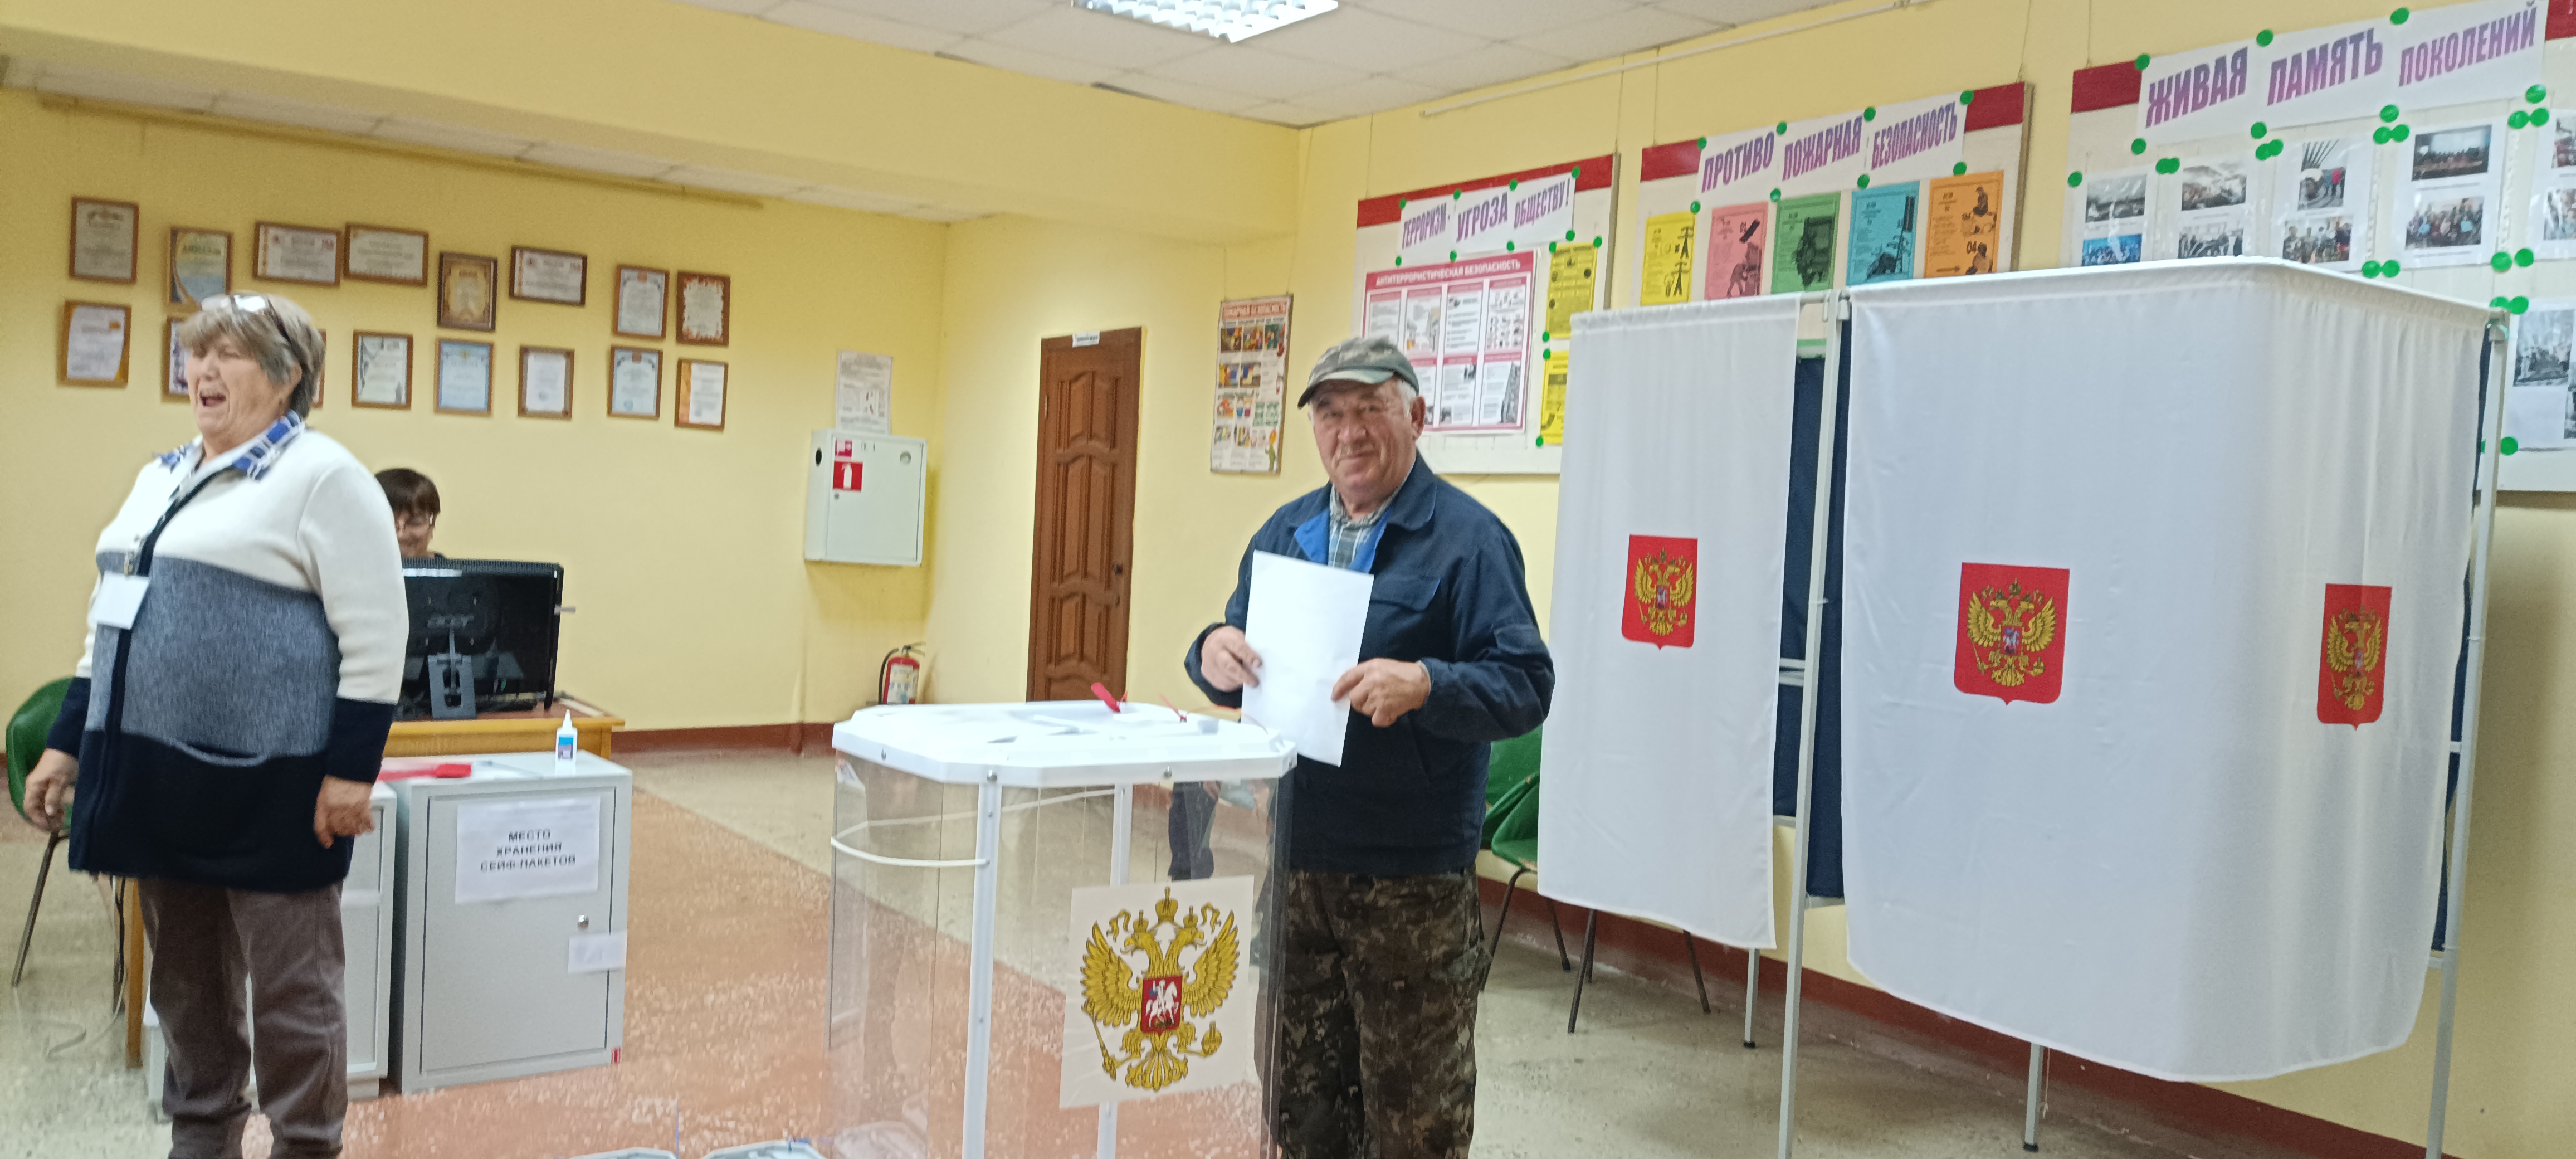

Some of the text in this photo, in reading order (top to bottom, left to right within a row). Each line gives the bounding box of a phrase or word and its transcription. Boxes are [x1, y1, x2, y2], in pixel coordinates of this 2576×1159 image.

[2145, 1, 2537, 128] ЖИВАЯ ПАМЯТЬ ПОКОЛЕНИЙ
[1701, 101, 1958, 193] ПРОТИВО ПОЖАРНАЯ БЕЗОПАСНОСТЬ
[1456, 192, 1508, 242] УГРОЗА
[1514, 179, 1570, 229] ОБЩЕСТВУ!
[1375, 259, 1521, 287] АНТИТЕРРОРИСТИЧЕСКАЯ БЕЗОПАСНОСТЬ
[497, 842, 562, 858] ХРАНЕНИЯ
[509, 829, 551, 843] МЕСТО
